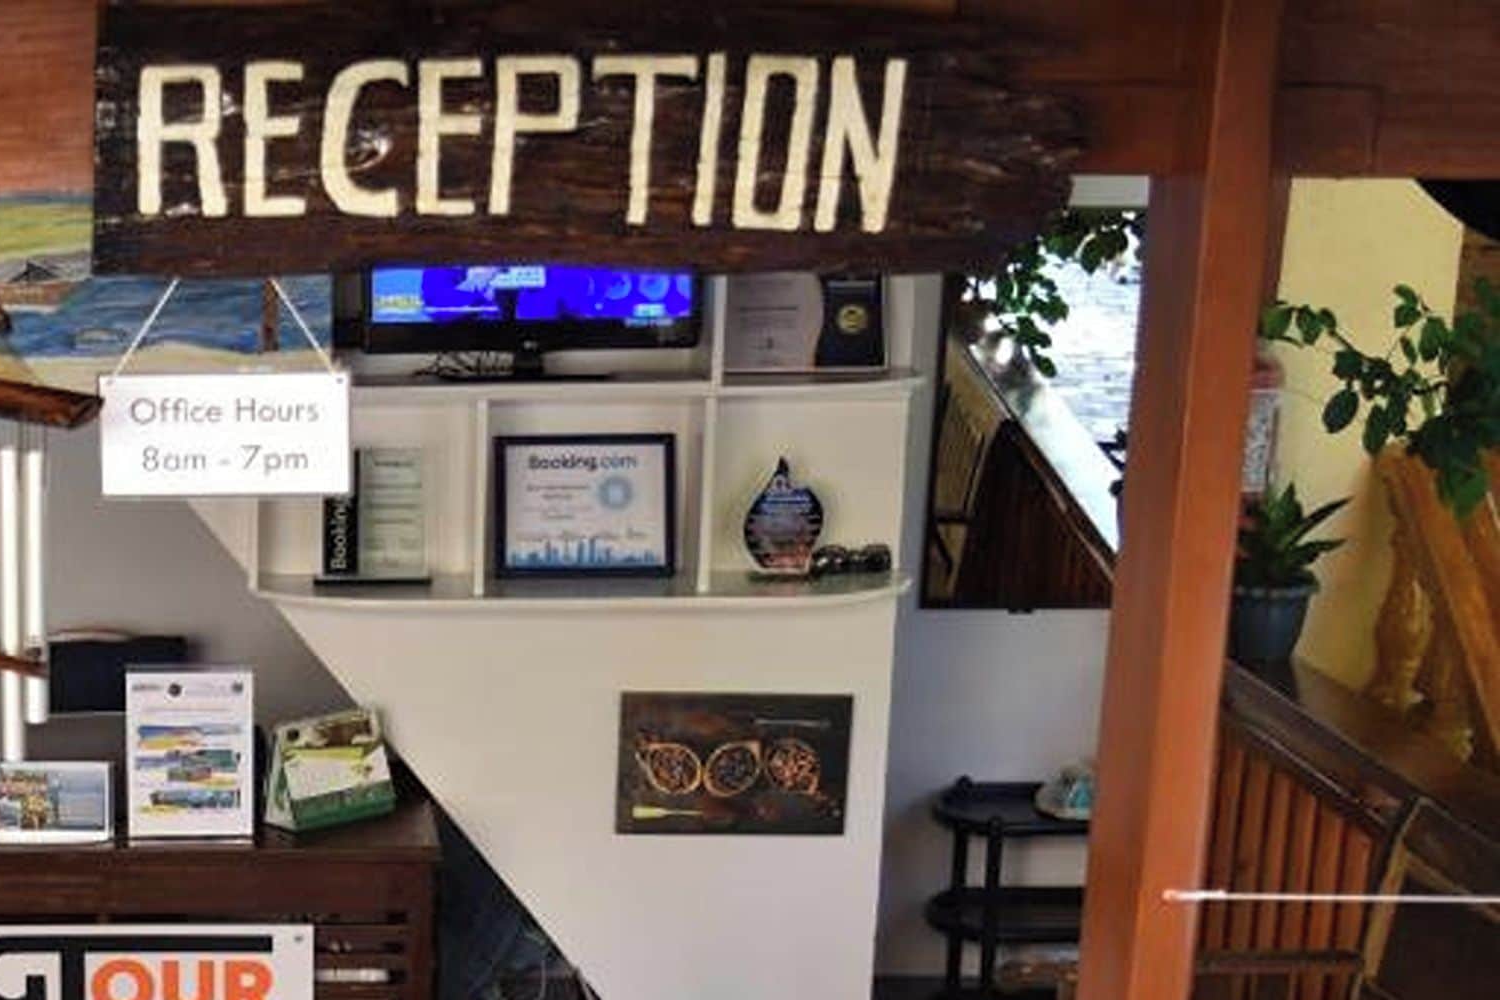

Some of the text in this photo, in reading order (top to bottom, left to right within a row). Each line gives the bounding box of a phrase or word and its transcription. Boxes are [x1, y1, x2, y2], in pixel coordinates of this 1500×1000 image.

[137, 50, 908, 234] RECEPTION
[130, 397, 320, 425] Office Hours
[142, 445, 207, 471] 8am
[240, 444, 309, 477] 7pm
[528, 453, 638, 472] Booking.com
